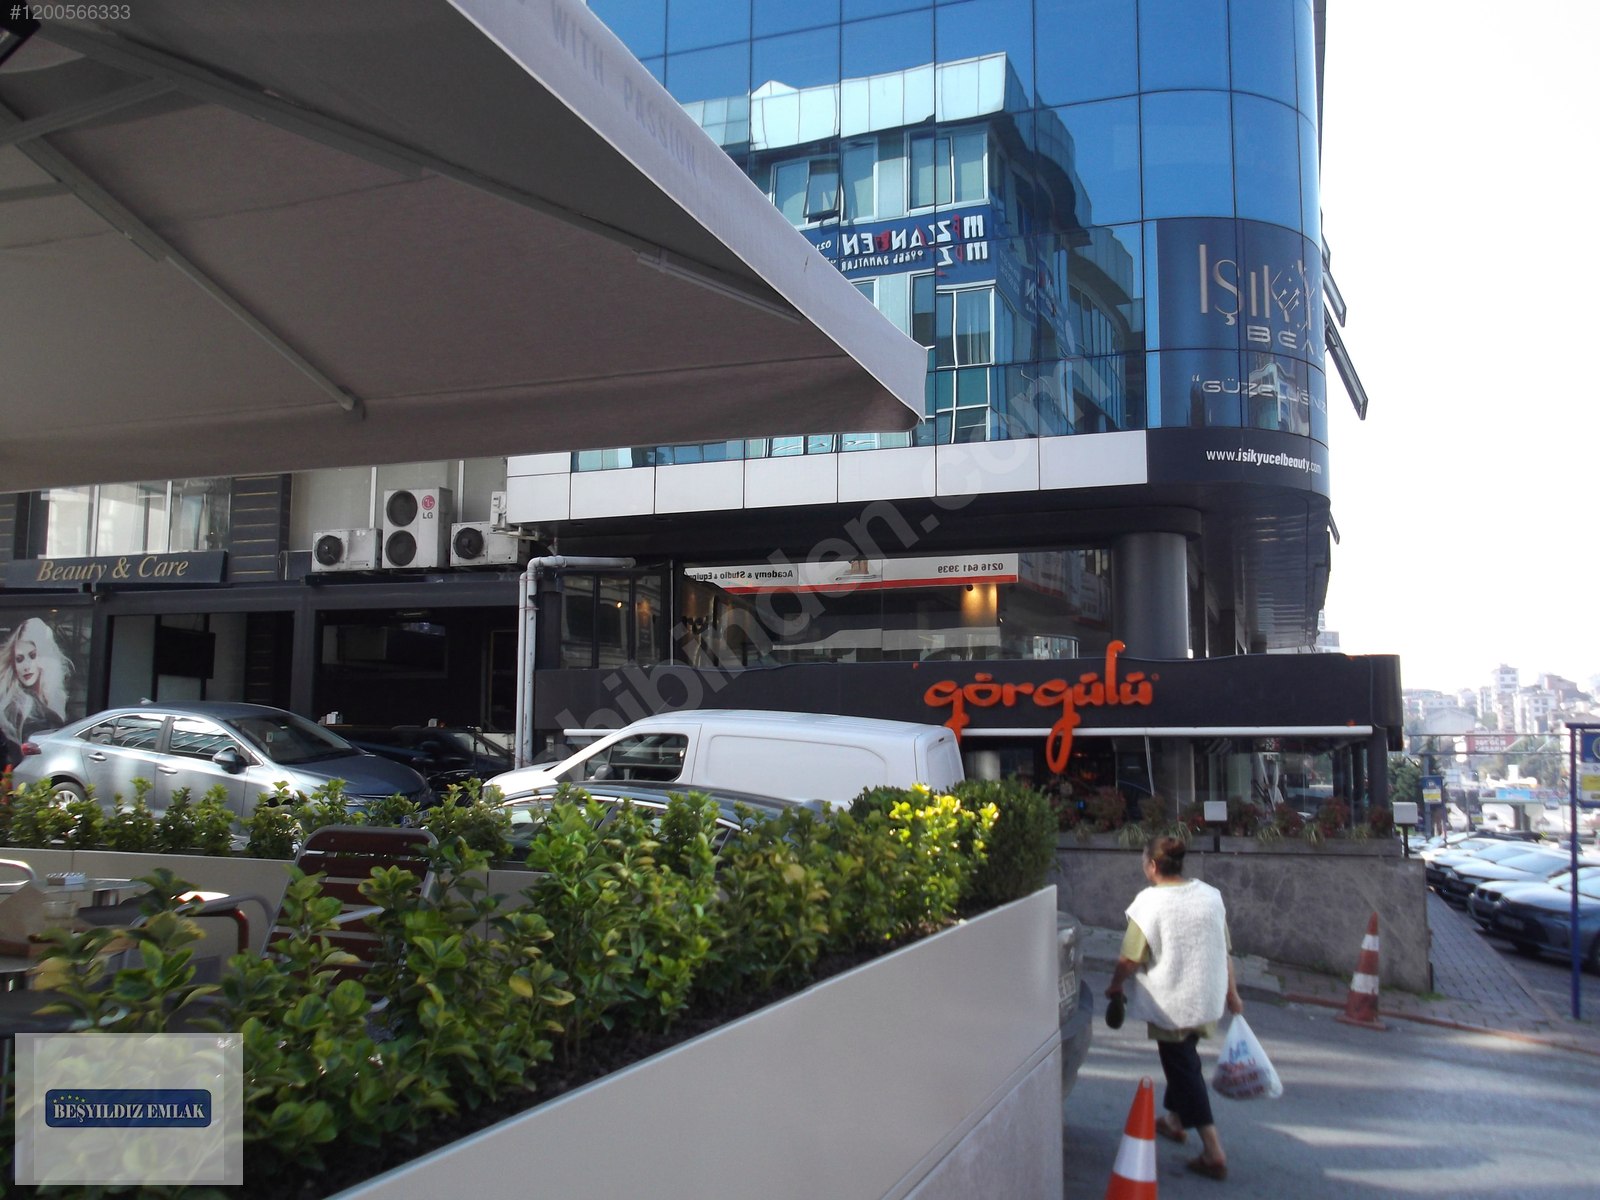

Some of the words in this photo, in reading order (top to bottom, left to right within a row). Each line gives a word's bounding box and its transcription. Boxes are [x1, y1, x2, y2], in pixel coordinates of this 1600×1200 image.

[552, 1, 605, 87] WITH
[623, 75, 698, 179] PASSION
[1206, 448, 1322, 475] www.isikyucelbeauty.com
[422, 511, 433, 519] LG
[36, 560, 107, 582] Beauty
[112, 556, 130, 579] &
[138, 555, 189, 577] Care
[923, 639, 1154, 775] görgülü
